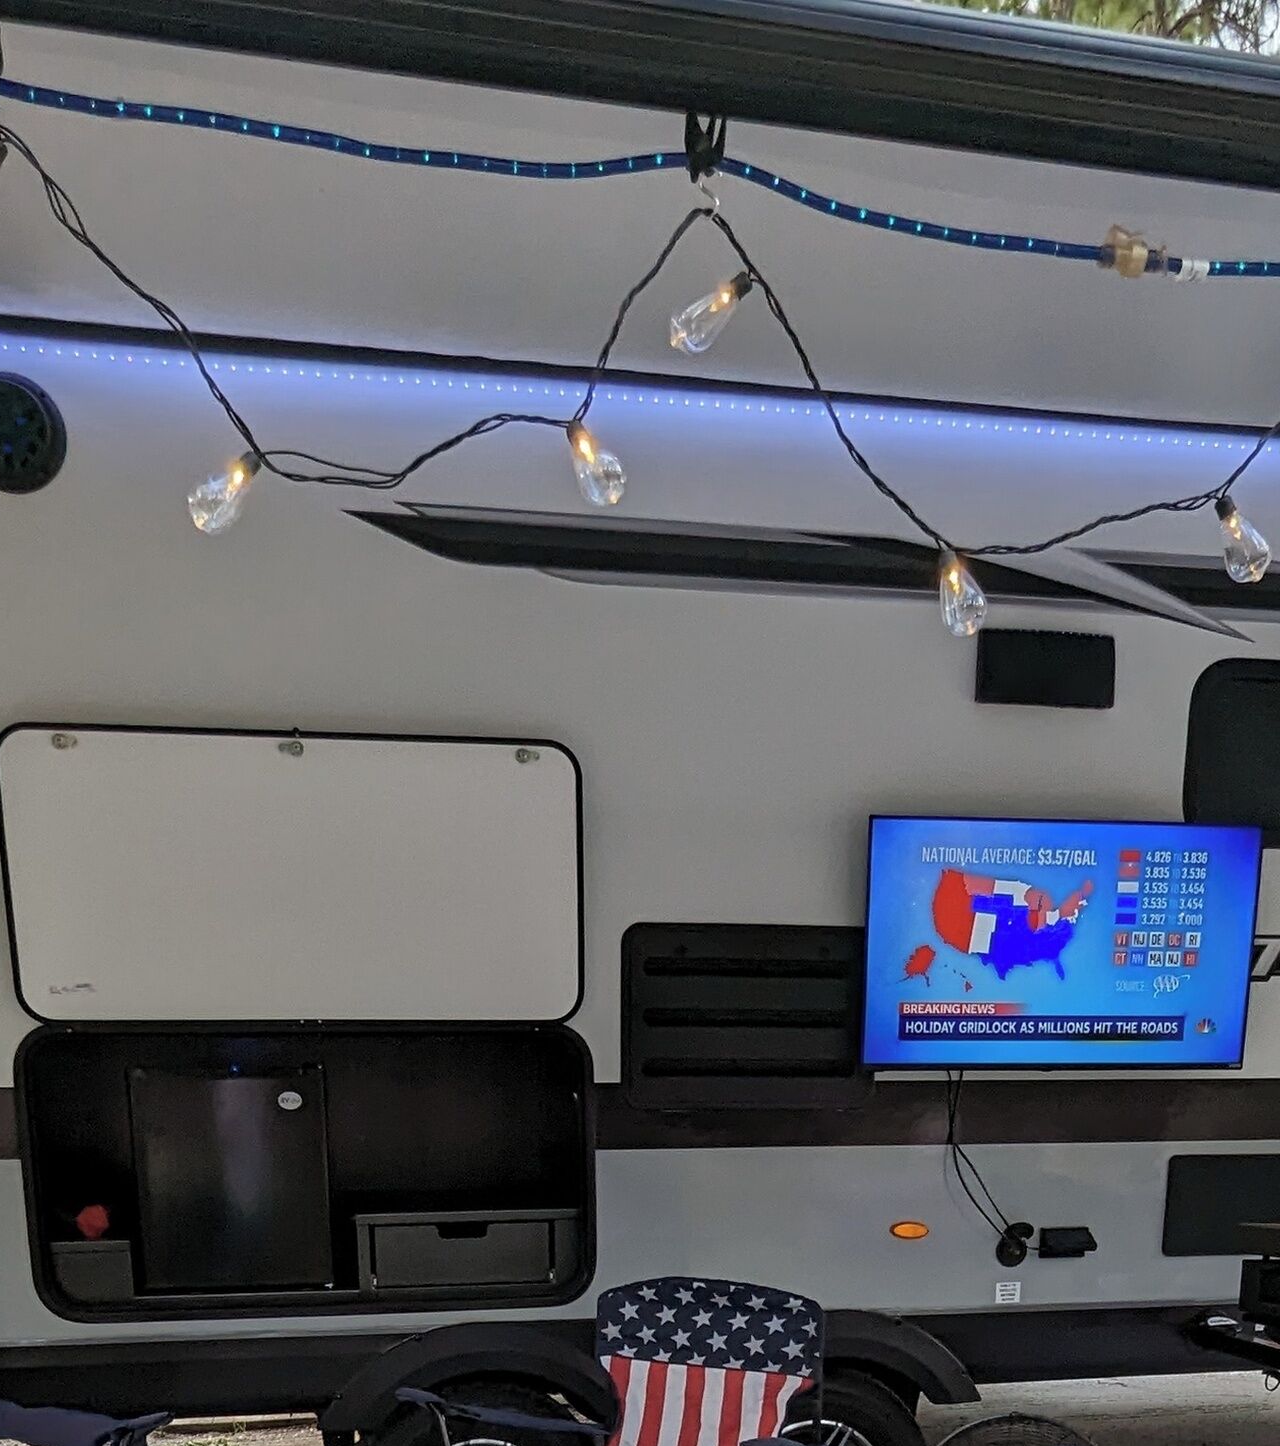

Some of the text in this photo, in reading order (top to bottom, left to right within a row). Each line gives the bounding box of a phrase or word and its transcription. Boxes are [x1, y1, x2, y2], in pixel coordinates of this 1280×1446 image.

[922, 847, 1098, 867] NATIONAL AVERAGE: $3.57/GAL
[1145, 866, 1170, 878] 3.835
[1181, 867, 1207, 880] 3.536
[1143, 882, 1169, 894] 3.535
[1180, 883, 1205, 895] 3.454
[1142, 897, 1168, 909] 3.535
[1179, 898, 1203, 910] 3.454
[903, 1003, 996, 1014] BREAKING NEWS
[905, 1021, 1179, 1034] HOLIDAY GRIDLOCK AS MILLIONS HIT THE ROADS
